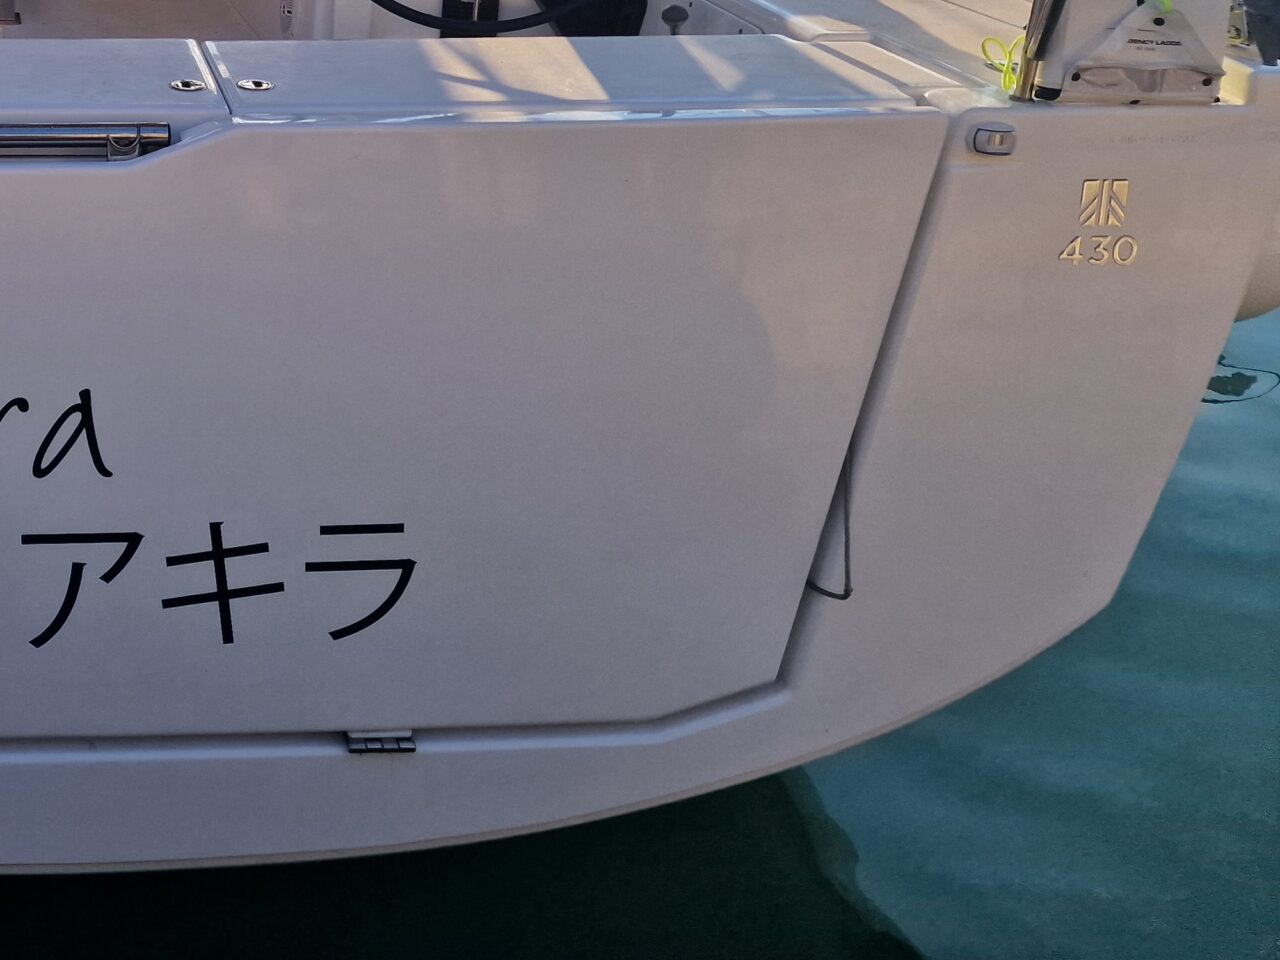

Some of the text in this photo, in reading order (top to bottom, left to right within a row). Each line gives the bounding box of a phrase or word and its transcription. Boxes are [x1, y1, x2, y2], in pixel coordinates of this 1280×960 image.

[1058, 234, 1138, 266] 430
[22, 522, 416, 648] アキラ
